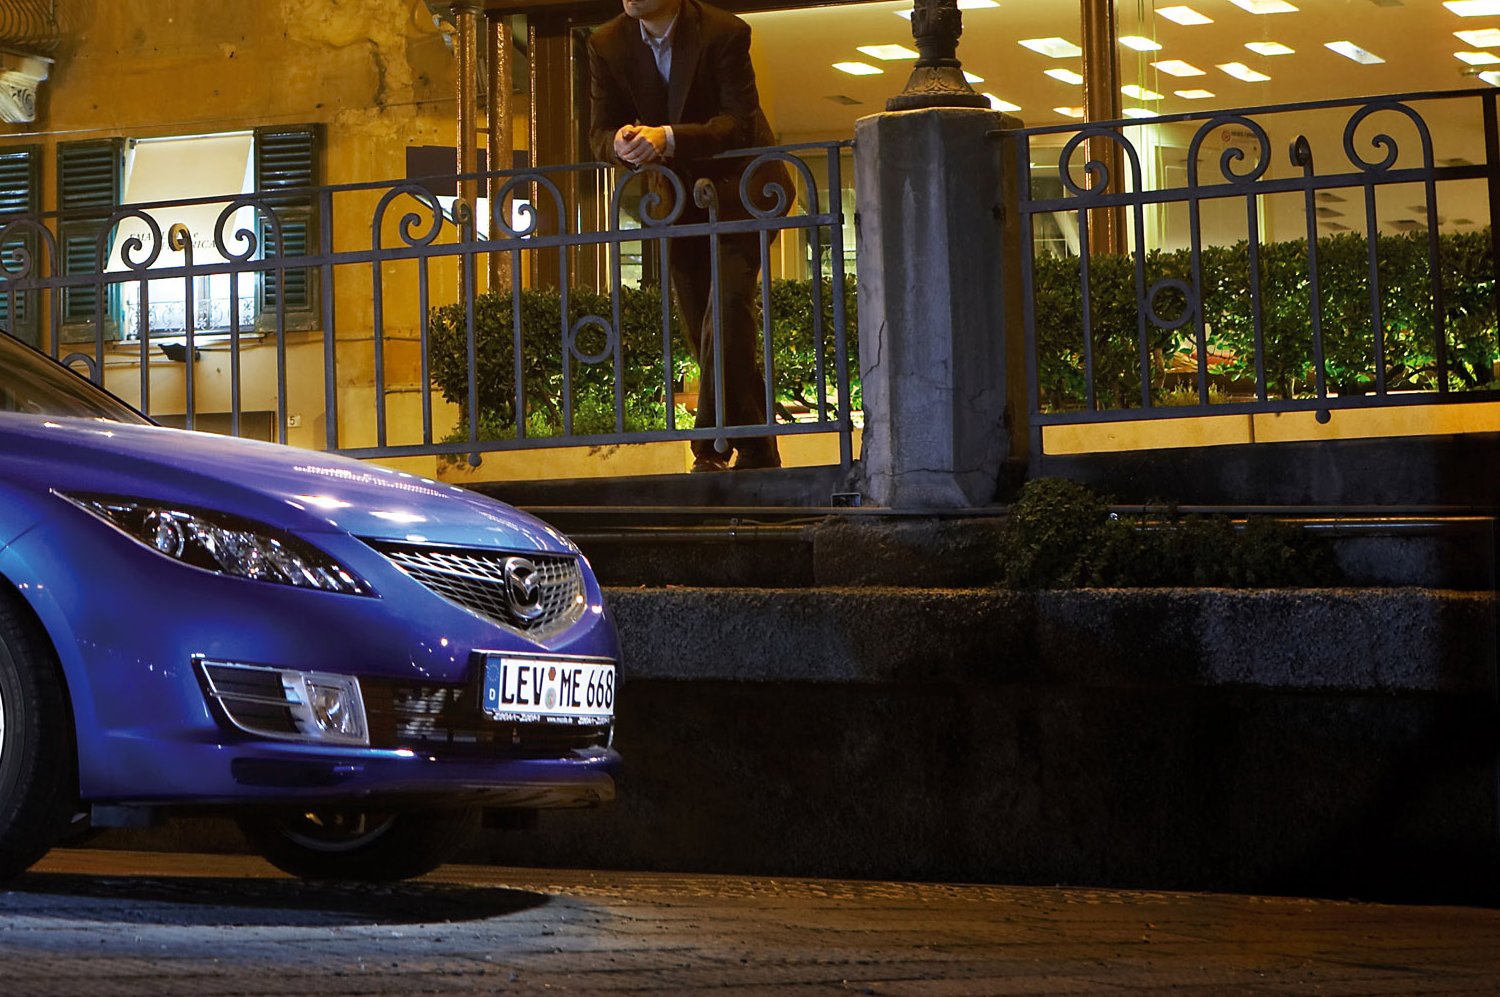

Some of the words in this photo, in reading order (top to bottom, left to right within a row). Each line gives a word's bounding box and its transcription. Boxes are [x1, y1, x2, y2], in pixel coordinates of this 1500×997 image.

[489, 688, 496, 701] D
[501, 665, 545, 706] LEV
[559, 668, 582, 708] ME
[586, 669, 613, 709] 668
